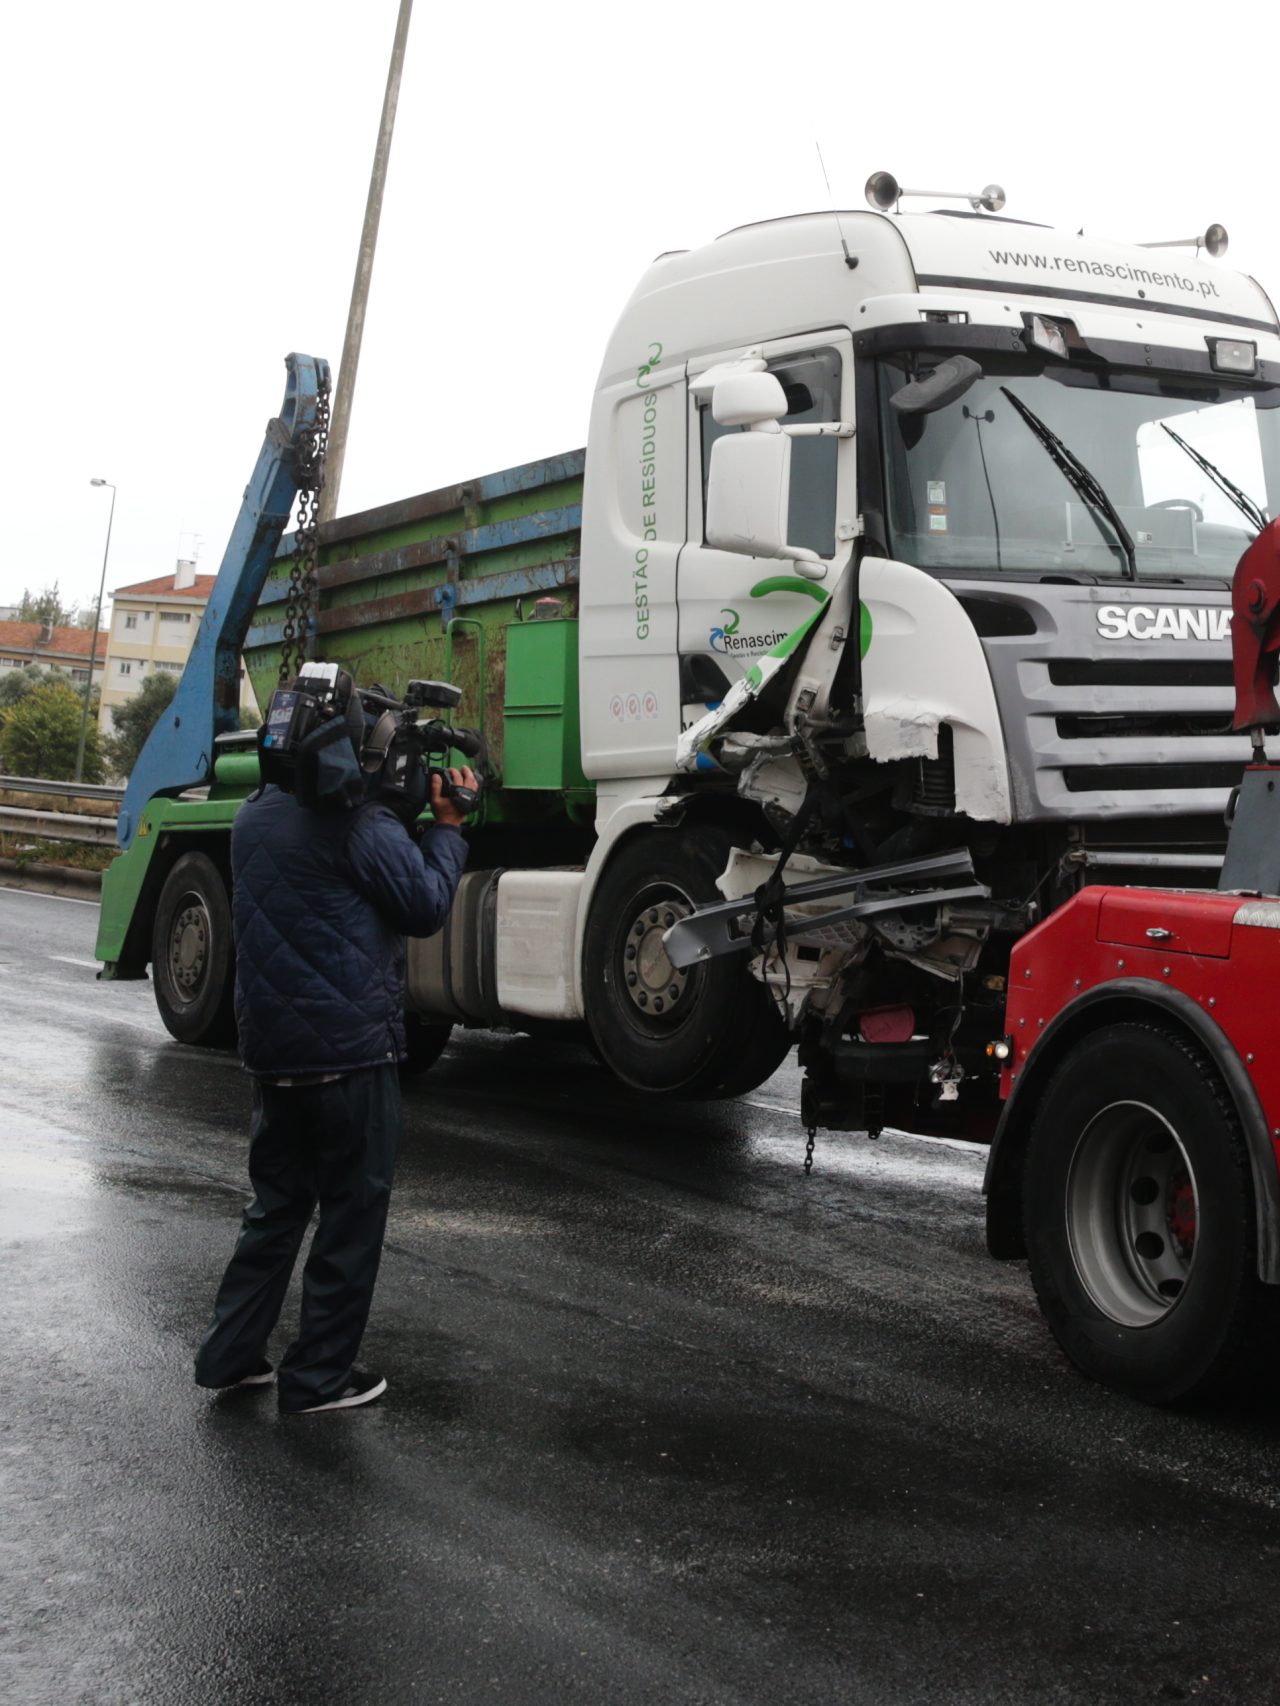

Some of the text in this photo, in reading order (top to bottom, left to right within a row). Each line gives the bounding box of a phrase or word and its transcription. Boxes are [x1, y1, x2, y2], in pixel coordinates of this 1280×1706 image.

[988, 249, 1220, 299] www.renascimento.pt
[633, 393, 658, 640] GESTÃO DE RESÍDUOS
